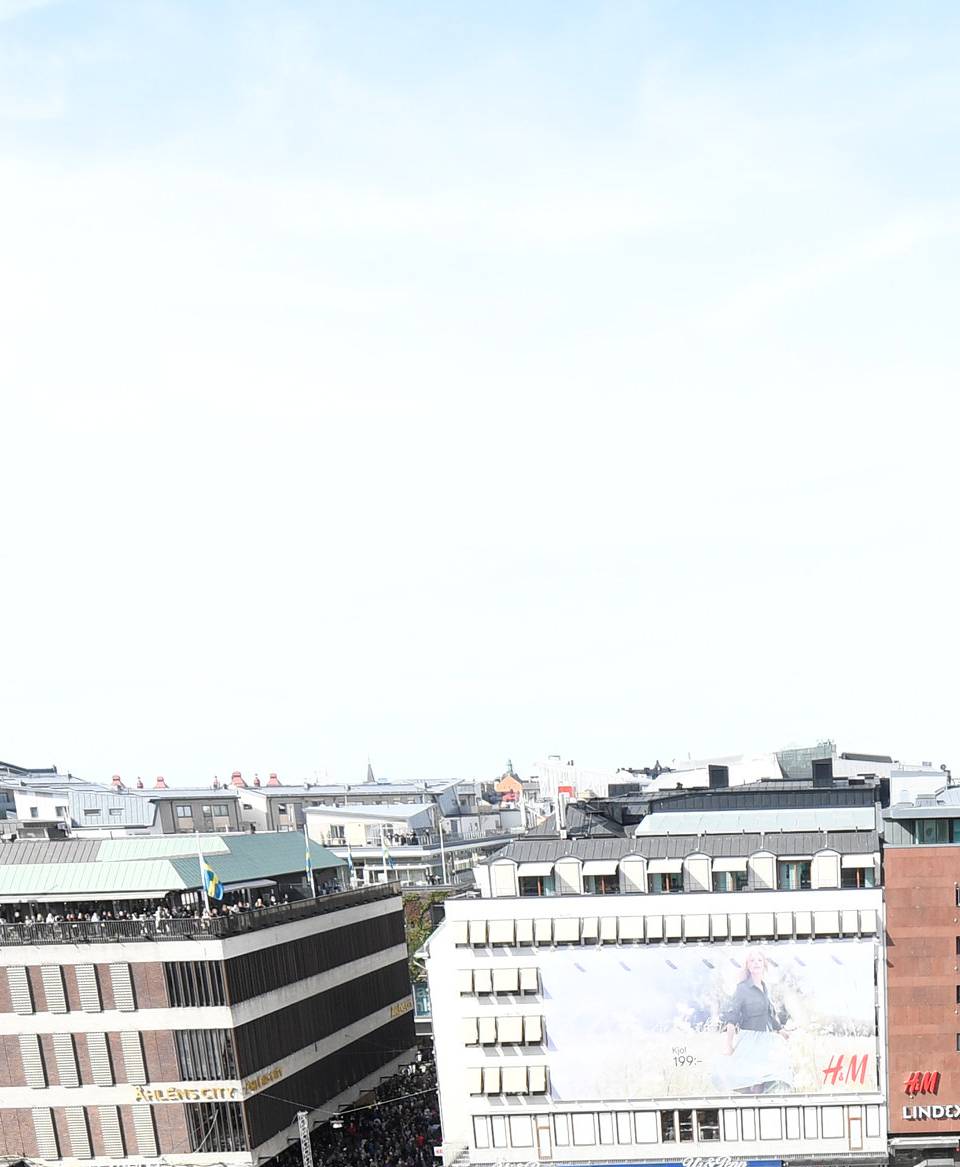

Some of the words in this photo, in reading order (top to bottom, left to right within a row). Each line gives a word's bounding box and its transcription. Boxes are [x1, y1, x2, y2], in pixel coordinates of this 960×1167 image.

[822, 1054, 868, 1085] H&M
[202, 1087, 237, 1100] CITY
[903, 1070, 940, 1094] H&M
